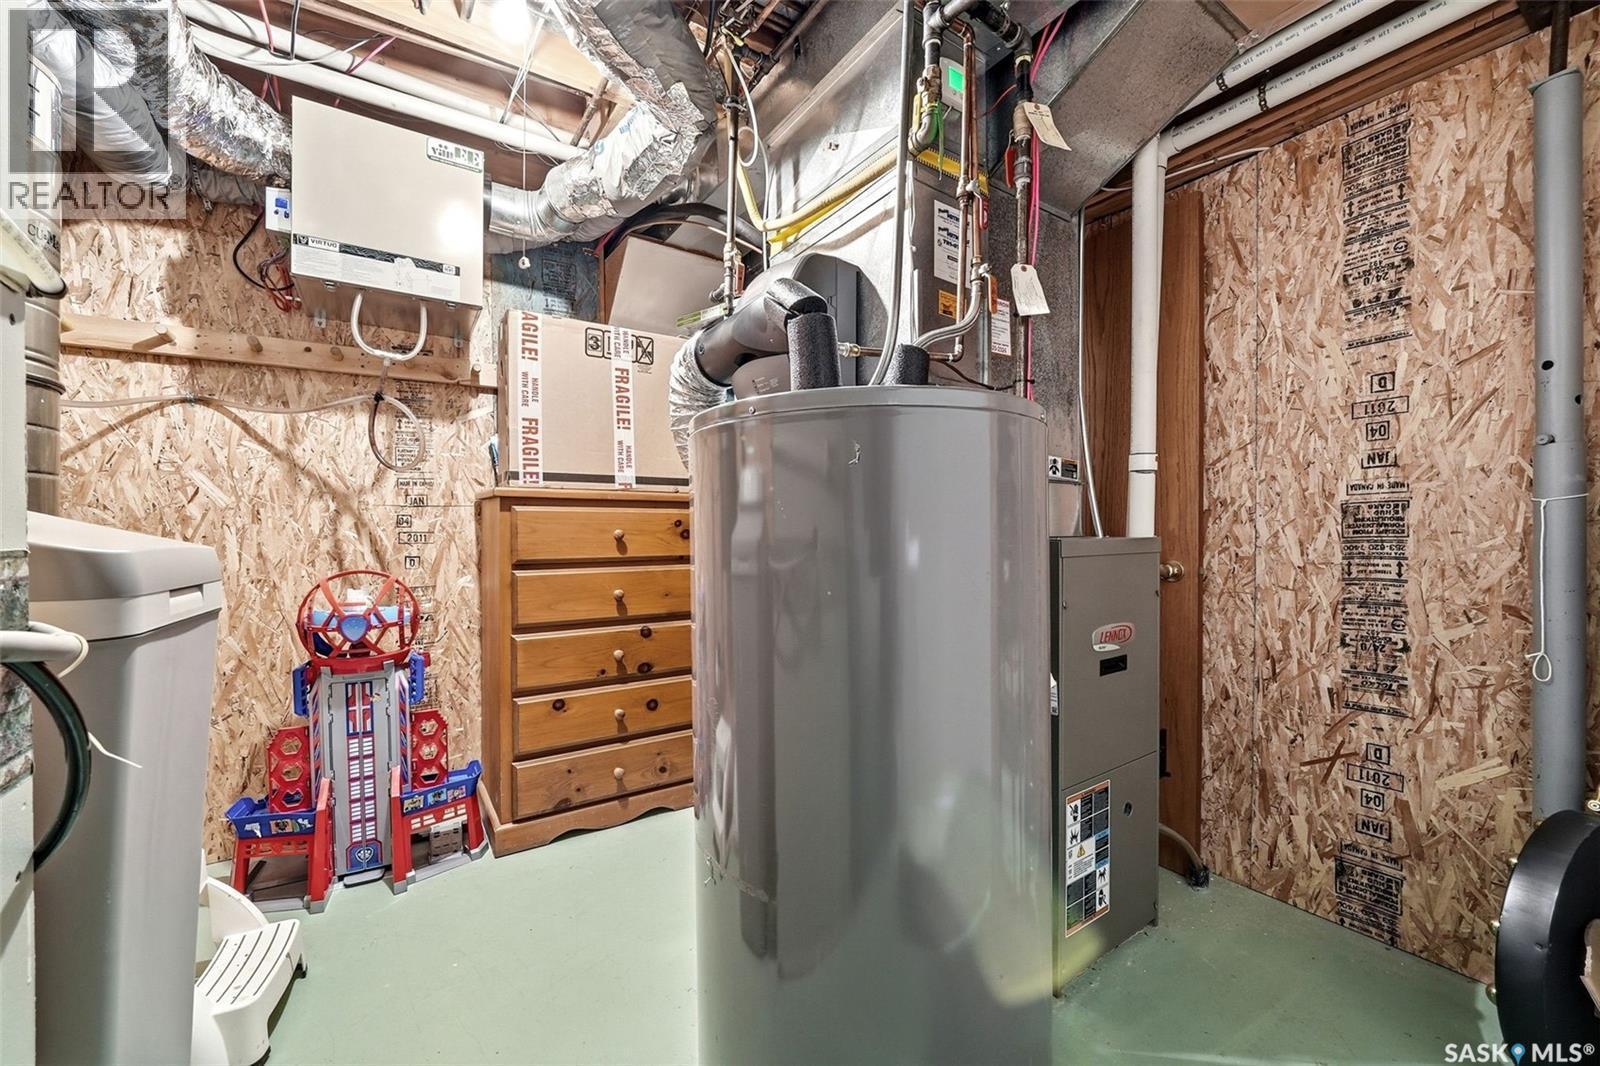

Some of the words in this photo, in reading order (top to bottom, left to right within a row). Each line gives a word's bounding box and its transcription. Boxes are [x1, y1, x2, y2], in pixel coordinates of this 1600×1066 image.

[521, 371, 529, 389] WITH
[1378, 377, 1387, 388] D
[521, 389, 529, 407] CARE
[615, 368, 631, 430] FRAGILE!
[1364, 400, 1396, 414] 2011
[1370, 425, 1386, 437] 04
[522, 417, 539, 485] FRAGILE!
[1367, 452, 1391, 466] JAN
[409, 497, 424, 506] JAN
[399, 516, 410, 526] 04
[407, 534, 427, 542] 2011
[1100, 629, 1126, 643] LENNOX
[1374, 749, 1383, 761] D
[1359, 770, 1390, 786] 2011
[1365, 793, 1381, 808] 04
[1361, 820, 1385, 835] JAN
